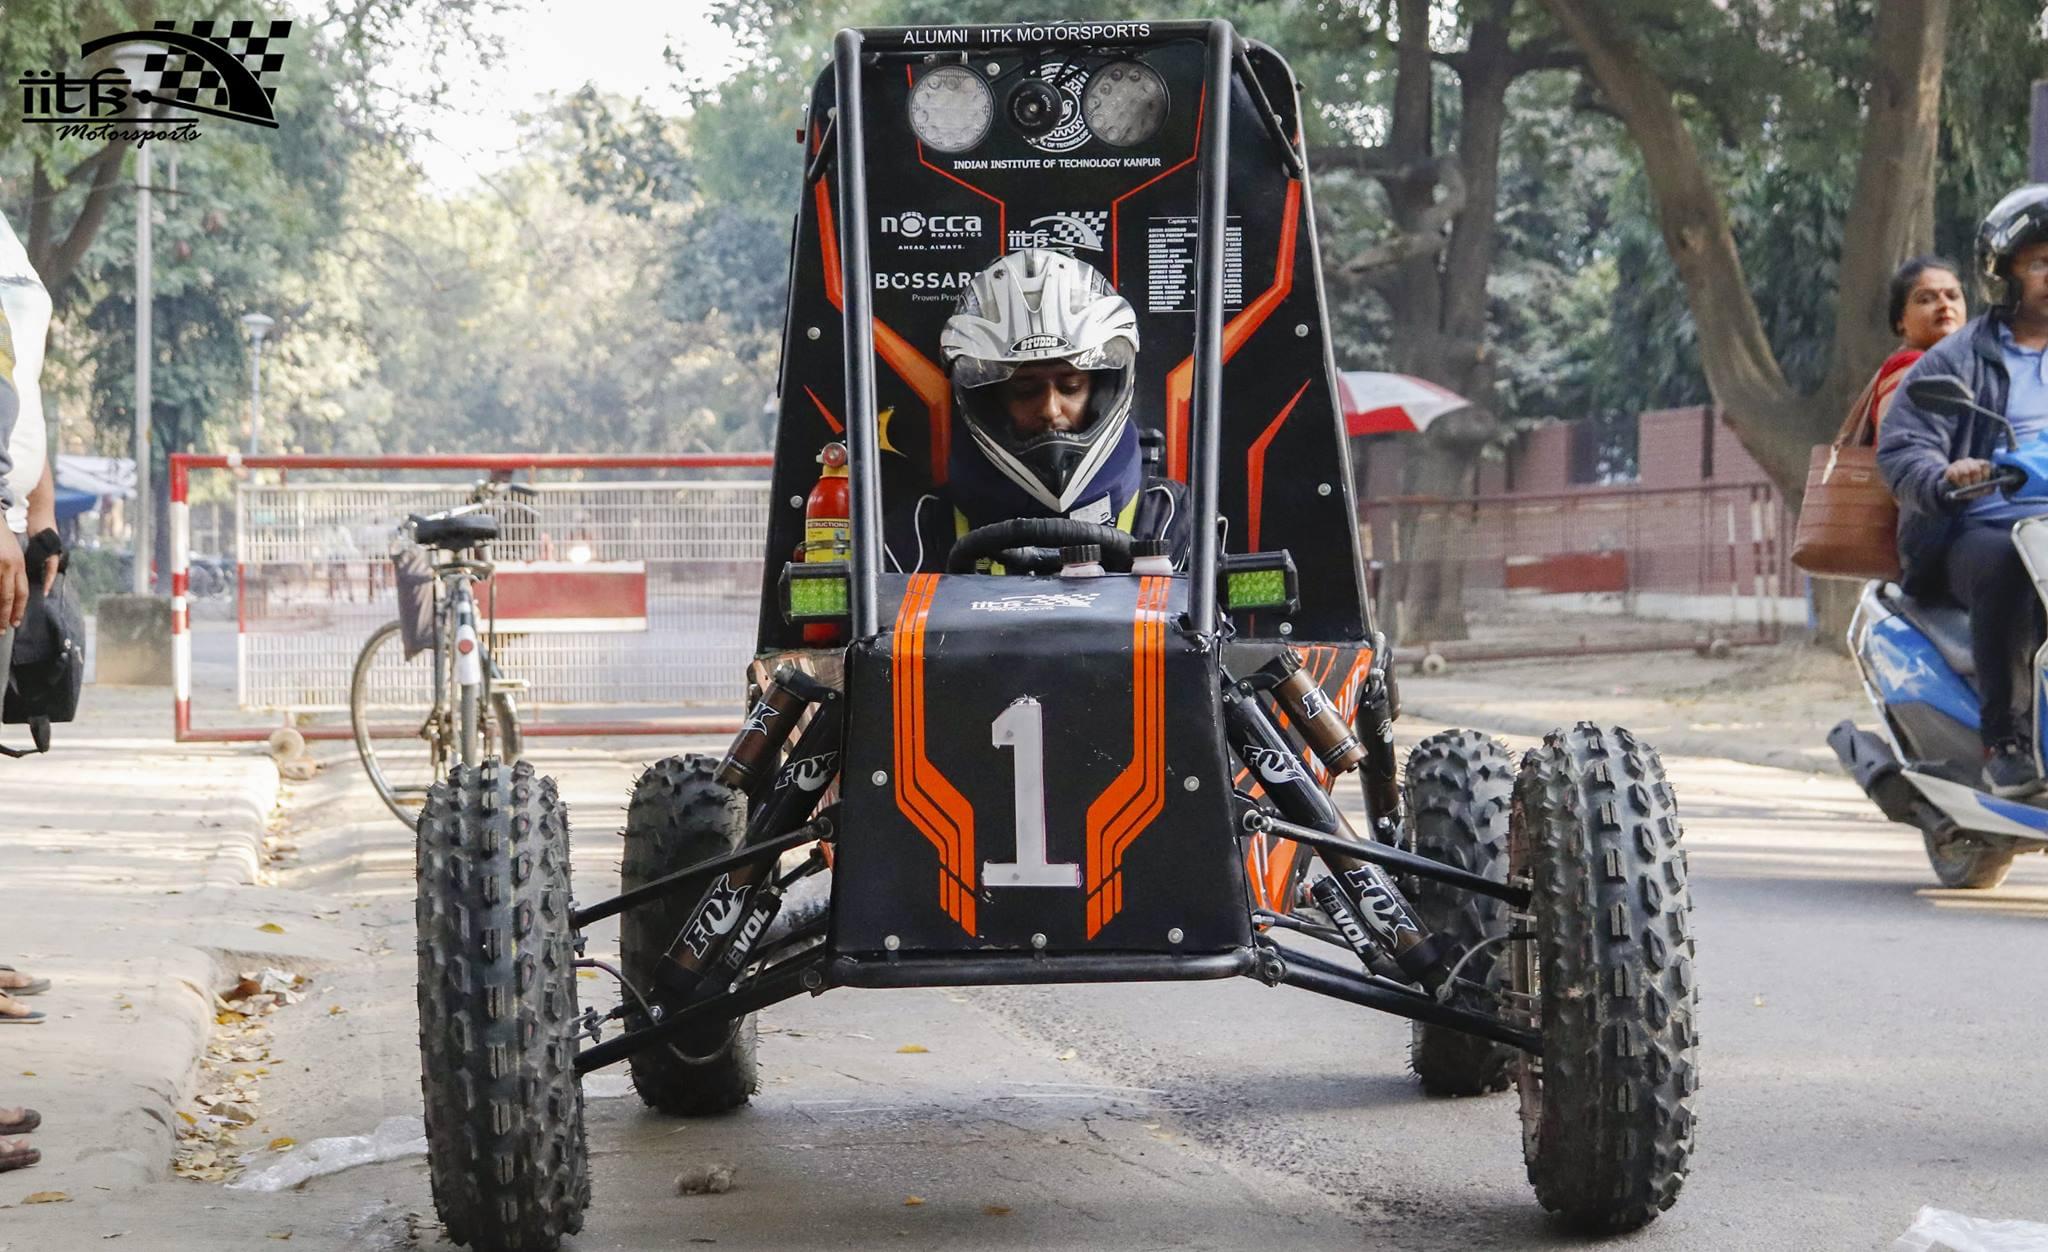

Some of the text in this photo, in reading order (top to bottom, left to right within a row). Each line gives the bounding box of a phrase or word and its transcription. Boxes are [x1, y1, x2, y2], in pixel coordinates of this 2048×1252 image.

[903, 24, 1151, 44] ALUMNI IITK MOTORSPORTS
[1056, 128, 1089, 149] TECHNOLOG
[954, 158, 1162, 170] INDIAN INSTITUTE OF TECHNOLOGY KANPUR
[875, 271, 983, 290] BOSSAR
[912, 294, 939, 302] Proven
[775, 751, 840, 791] FOX
[1243, 745, 1305, 783] FOX
[982, 696, 1081, 886] 1
[684, 873, 752, 959] FOX
[1344, 864, 1419, 949] FOX
